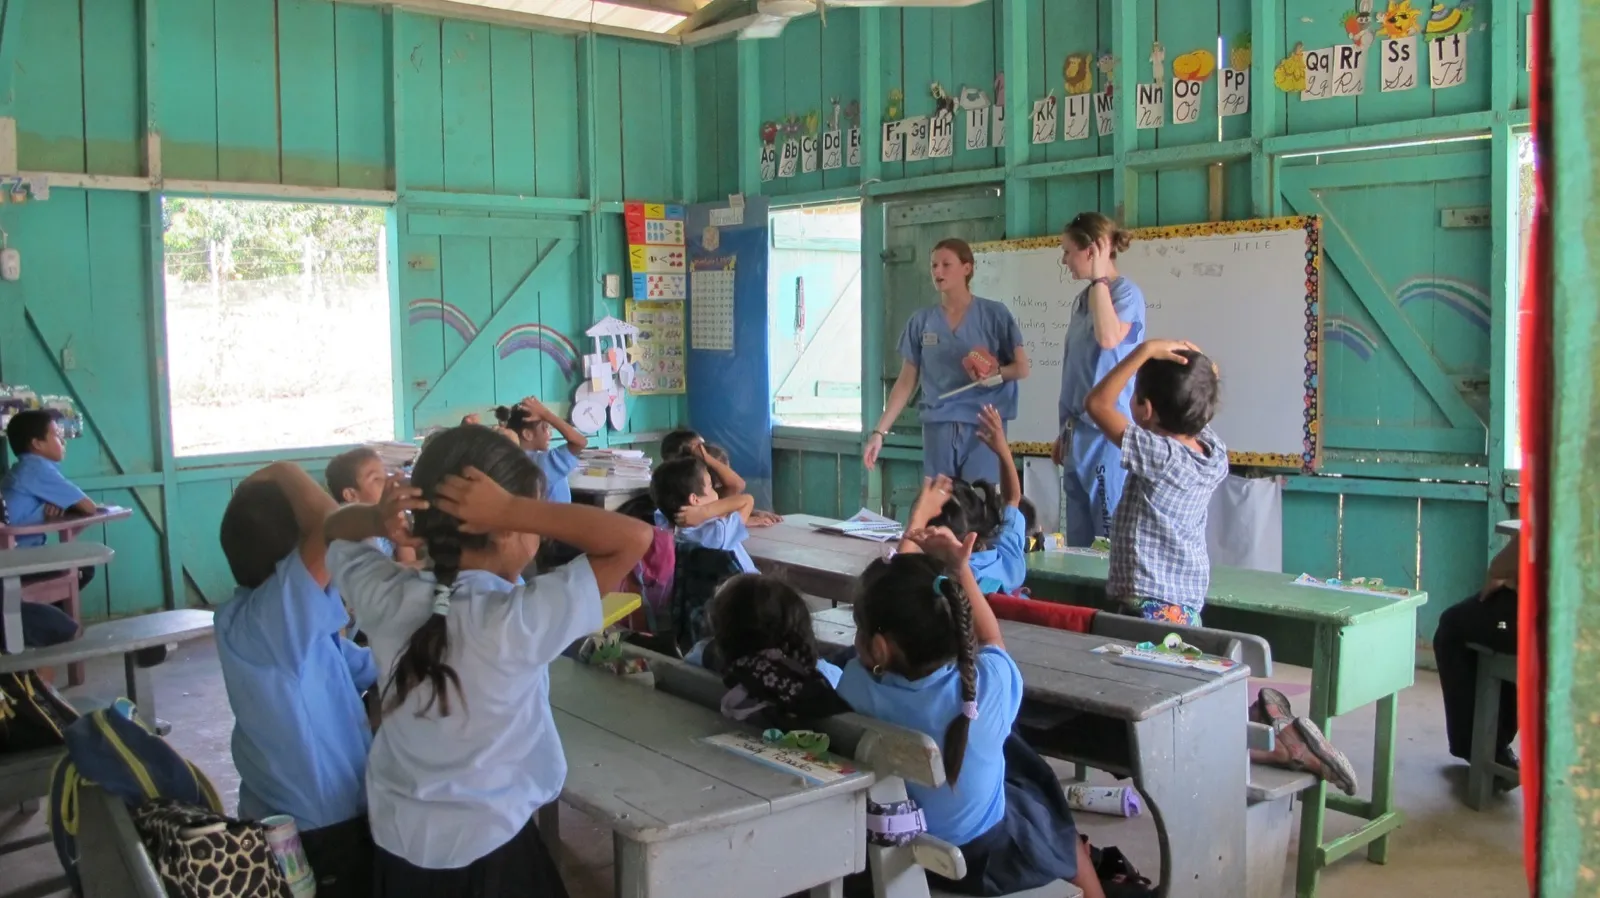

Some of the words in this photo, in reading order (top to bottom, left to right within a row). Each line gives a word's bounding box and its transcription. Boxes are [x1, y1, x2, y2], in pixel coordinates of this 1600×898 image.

[1388, 40, 1410, 63] Ss
[1435, 34, 1460, 60] Tt
[1306, 51, 1329, 73] Qq
[1340, 46, 1362, 70] Rr
[1174, 79, 1200, 98] Oo
[1225, 70, 1245, 90] Pp
[1383, 66, 1415, 91] Ss
[1140, 86, 1163, 105] Nn
[1176, 99, 1199, 122] Oo
[824, 129, 841, 149] Dd
[933, 121, 951, 137] Hh
[784, 143, 798, 160] Bb
[1013, 295, 1048, 313] Making
